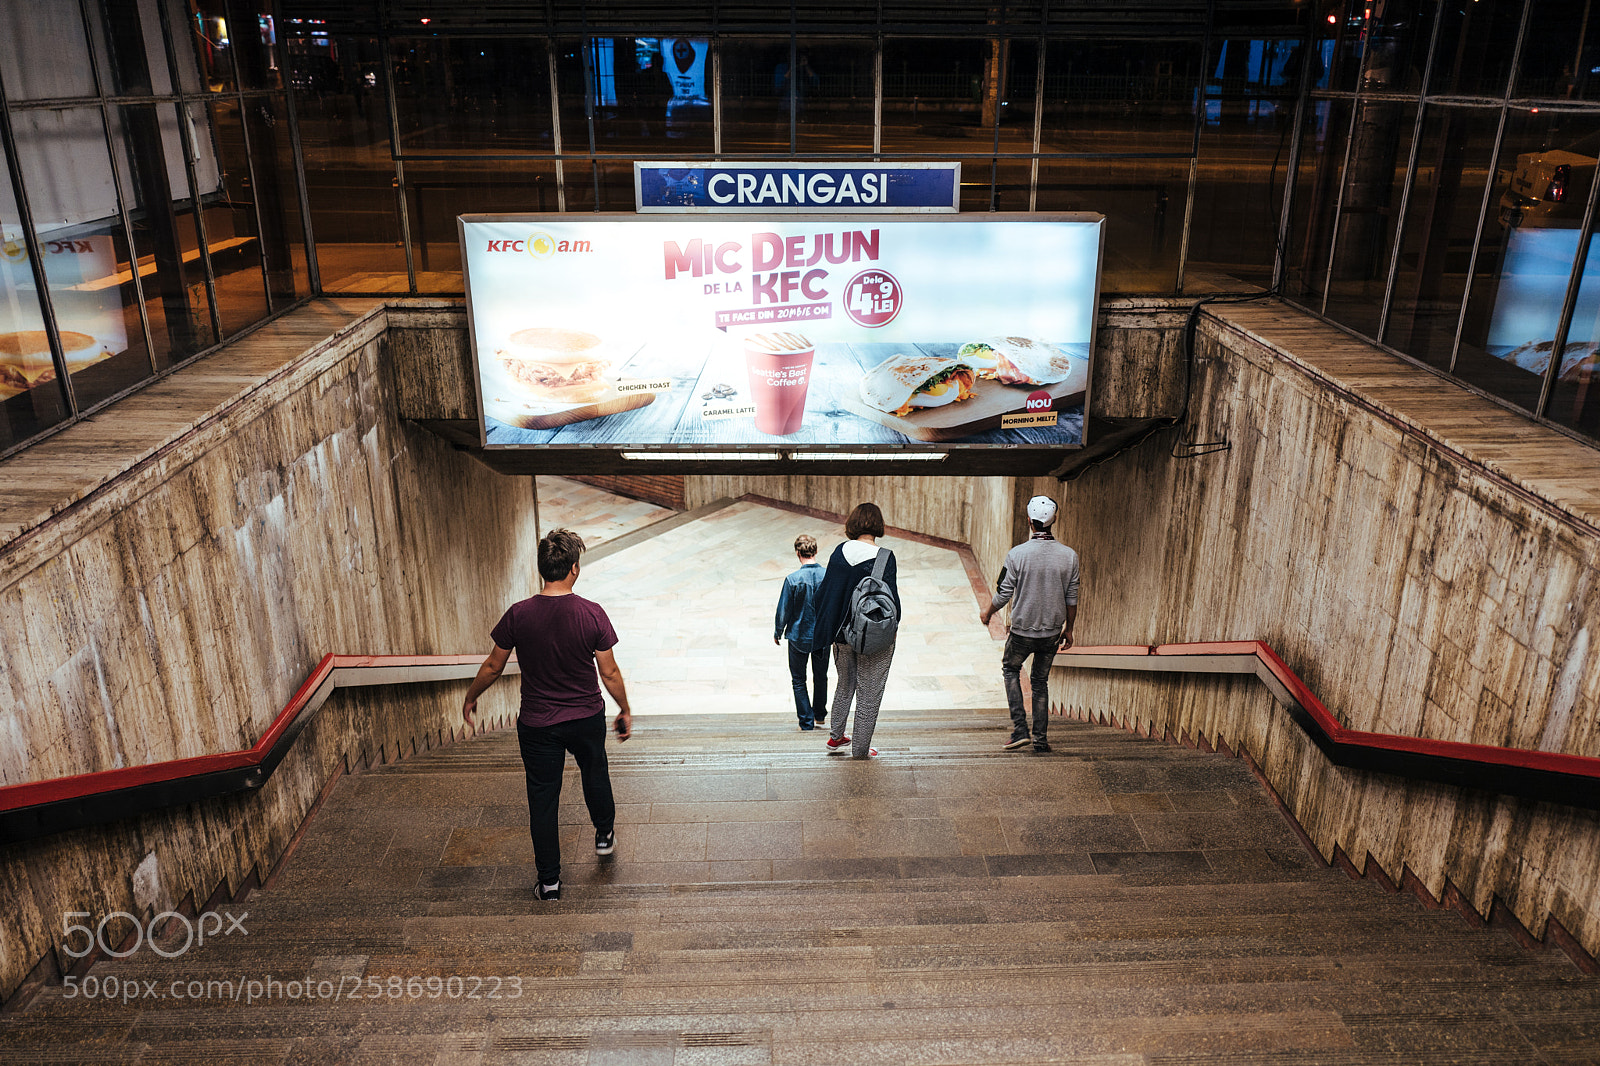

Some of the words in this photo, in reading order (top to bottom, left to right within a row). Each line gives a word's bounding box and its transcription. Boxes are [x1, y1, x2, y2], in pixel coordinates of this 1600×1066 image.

[707, 173, 888, 204] CRANGASI
[487, 240, 524, 253] KFC
[557, 240, 594, 253] a.m.
[703, 284, 721, 295] DE
[725, 282, 743, 293] LA
[752, 268, 830, 305] KFC
[874, 299, 894, 314] LEI
[719, 313, 731, 323] TE
[732, 311, 756, 322] FACE
[757, 310, 775, 320] DIN
[813, 305, 829, 315] OM
[617, 383, 647, 392] CHICKEN
[649, 381, 671, 389] TOAST
[766, 378, 796, 386] Coffee
[1026, 398, 1052, 409] NOU
[703, 408, 734, 417] CARAMEL
[736, 406, 756, 414] LATTE
[1003, 417, 1034, 425] MORNING
